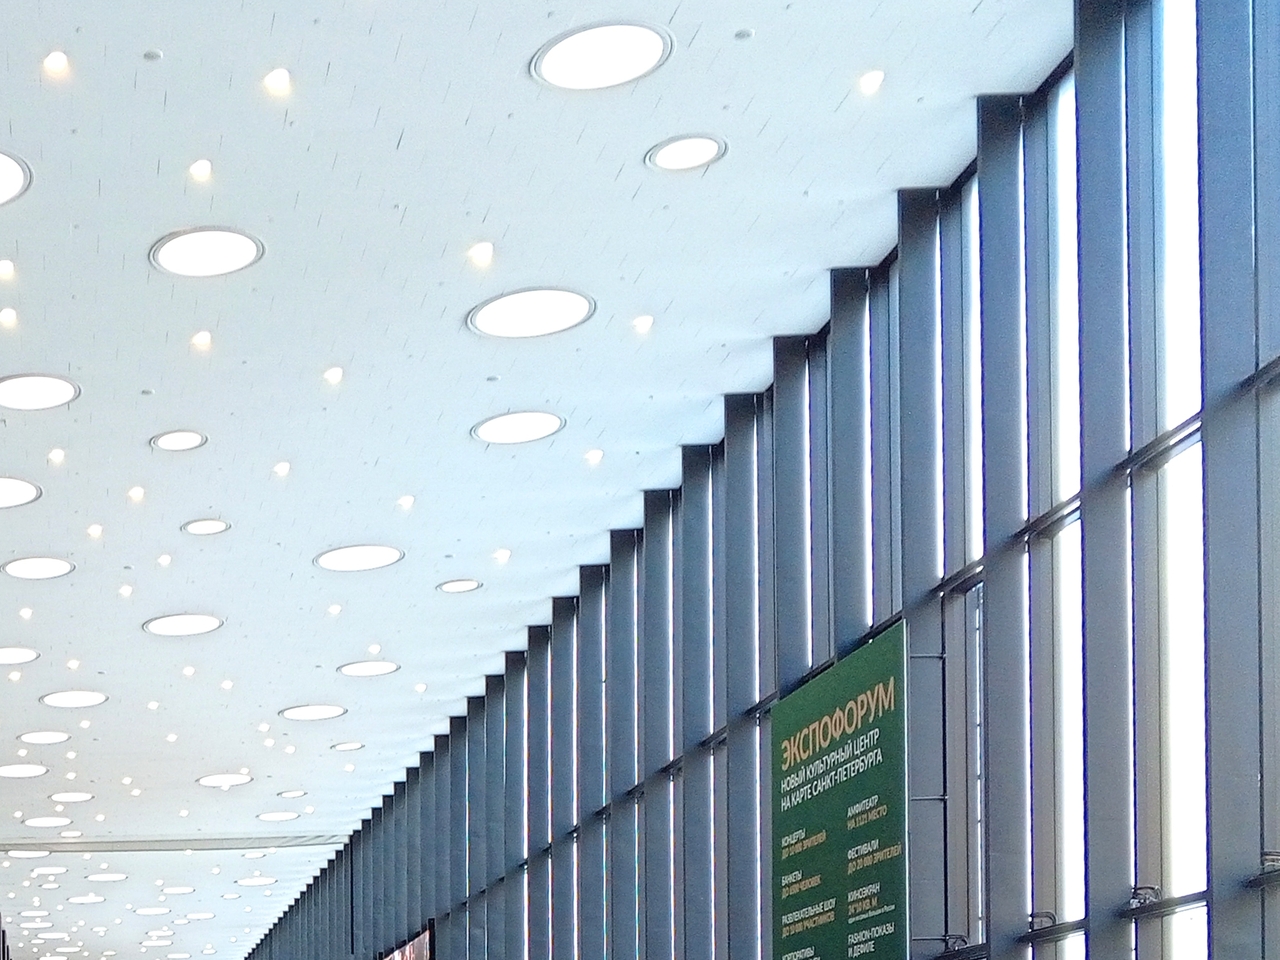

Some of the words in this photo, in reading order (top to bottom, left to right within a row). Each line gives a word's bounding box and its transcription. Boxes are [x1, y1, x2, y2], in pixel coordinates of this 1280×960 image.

[781, 676, 895, 771] ЭКСПОФОРУМ
[781, 766, 806, 793] НОВЫЙ
[806, 739, 853, 780] КУЛЬТУРНЫЙ
[853, 728, 880, 757] ЦЕНТР
[781, 795, 791, 812] НА
[791, 784, 811, 807] КАРТЕ
[812, 748, 883, 796] САНКТ-ПЕТЕРБУРГА
[847, 922, 895, 945] FASHION-ПОКАЗЫ
